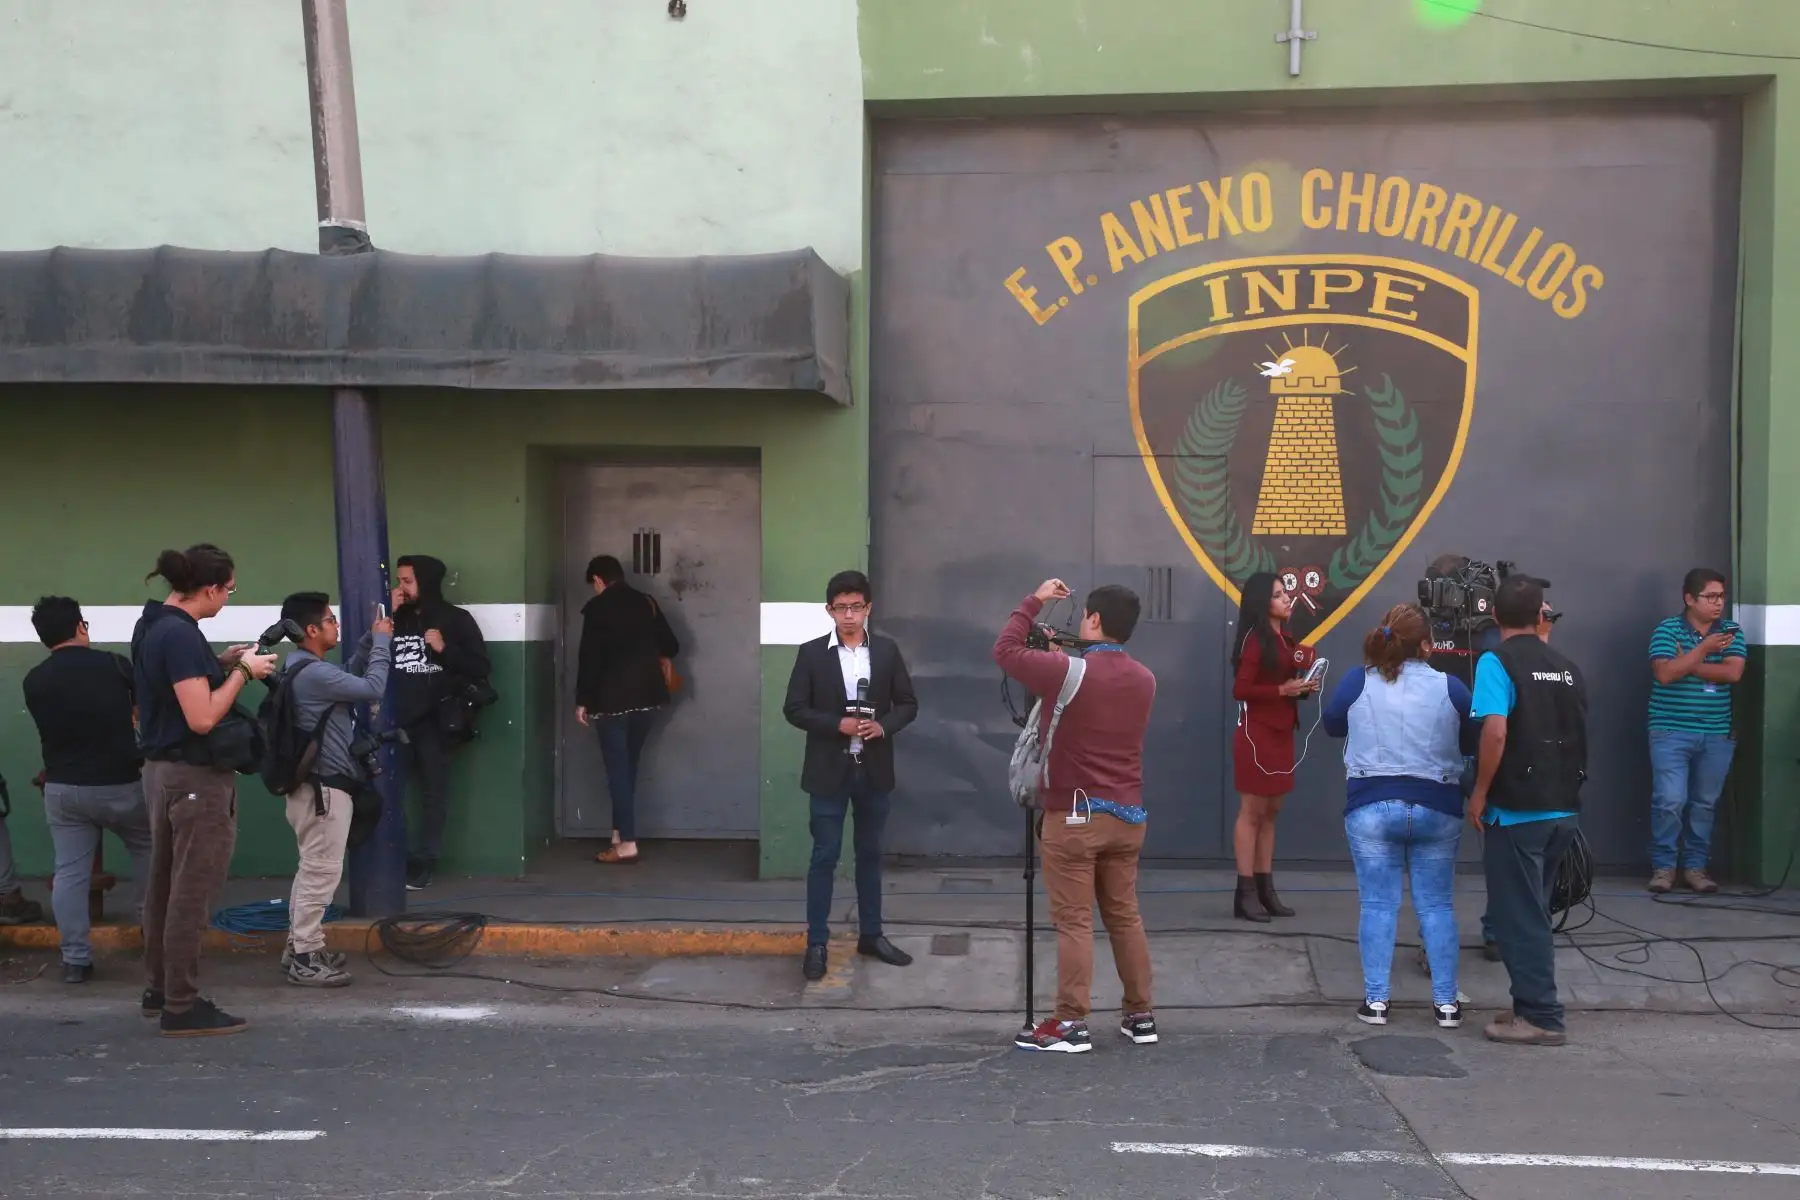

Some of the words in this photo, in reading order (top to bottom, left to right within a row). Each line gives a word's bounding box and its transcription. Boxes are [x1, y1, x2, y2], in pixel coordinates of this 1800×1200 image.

[1099, 169, 1276, 273] ANEXO
[1298, 167, 1605, 321] CHORRILLOS
[1203, 268, 1427, 322] INPE
